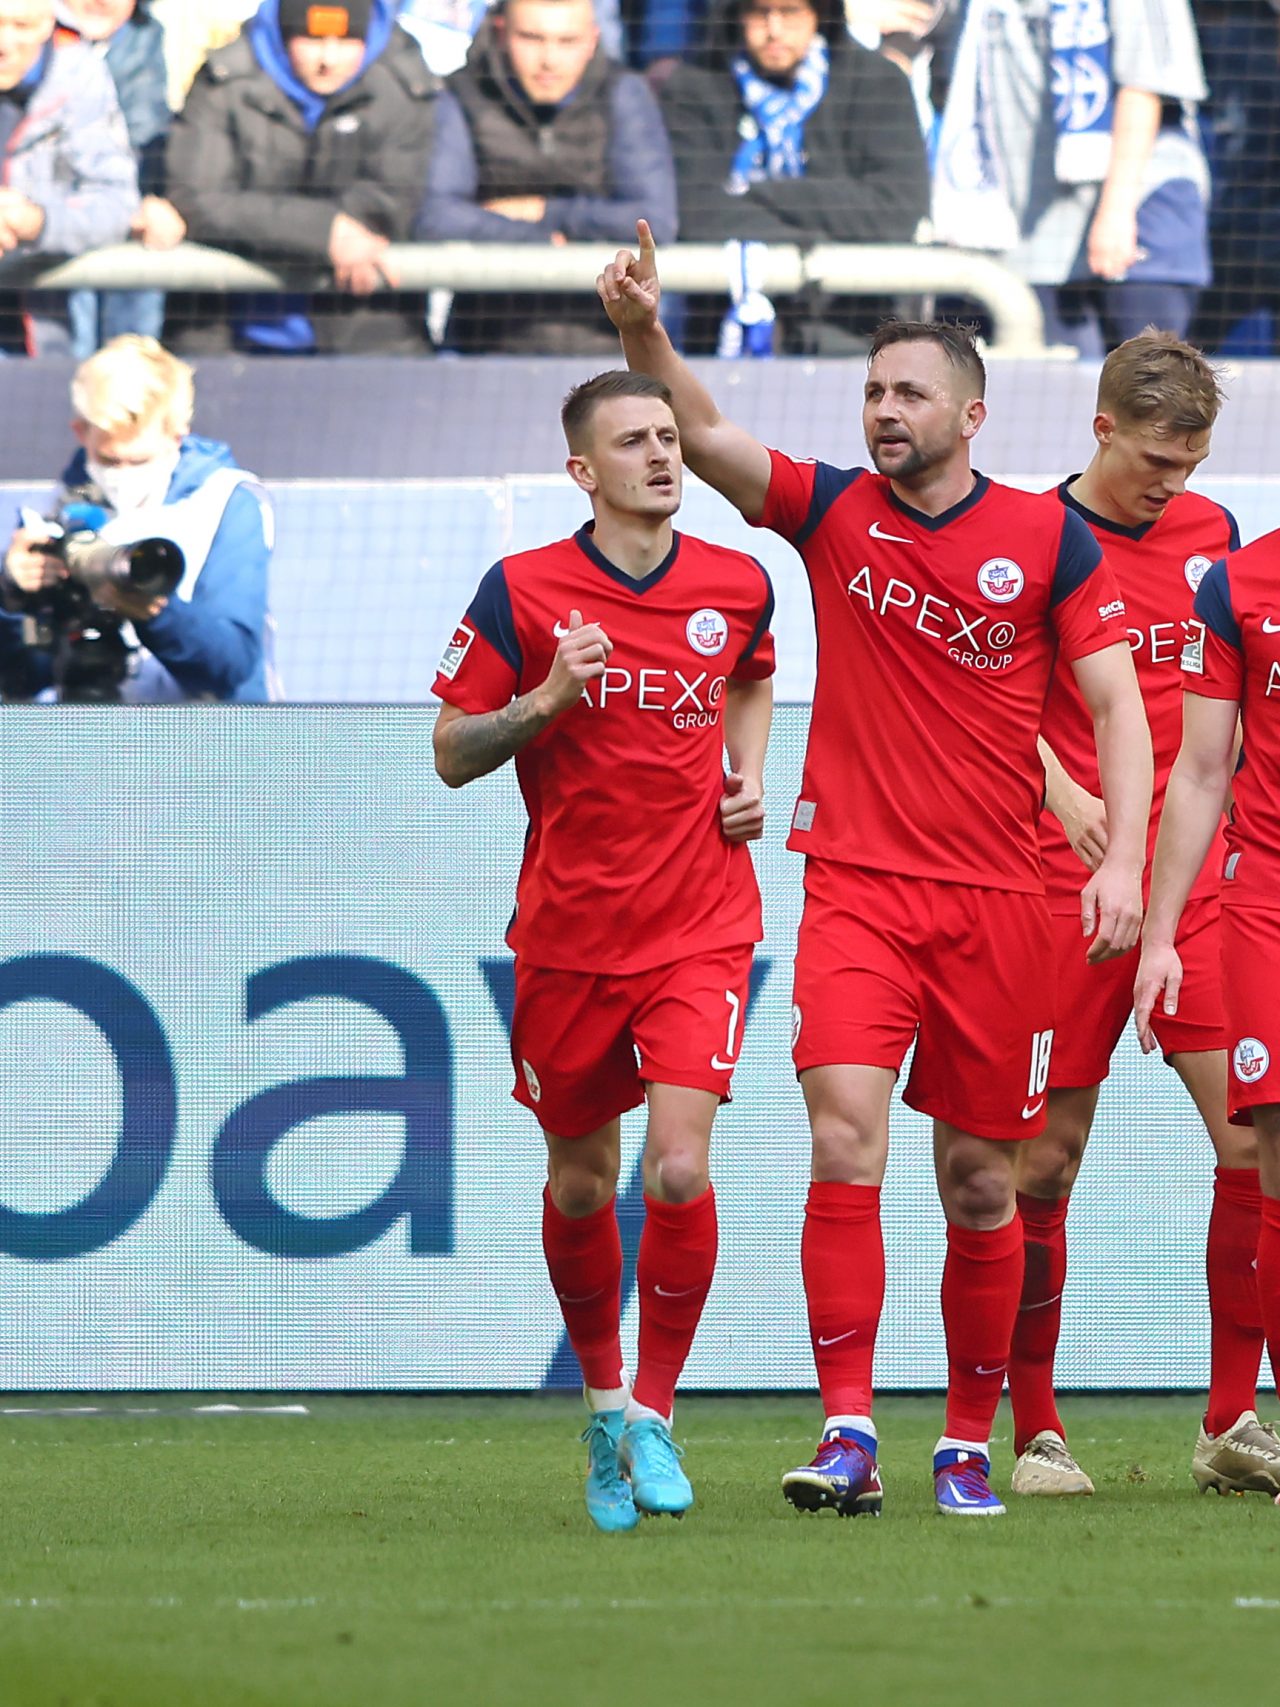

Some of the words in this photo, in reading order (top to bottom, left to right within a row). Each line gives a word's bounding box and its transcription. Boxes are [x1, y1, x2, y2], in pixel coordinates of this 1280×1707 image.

[848, 566, 987, 652] APEX
[947, 647, 1012, 670] GROUP
[1027, 1028, 1055, 1097] 18
